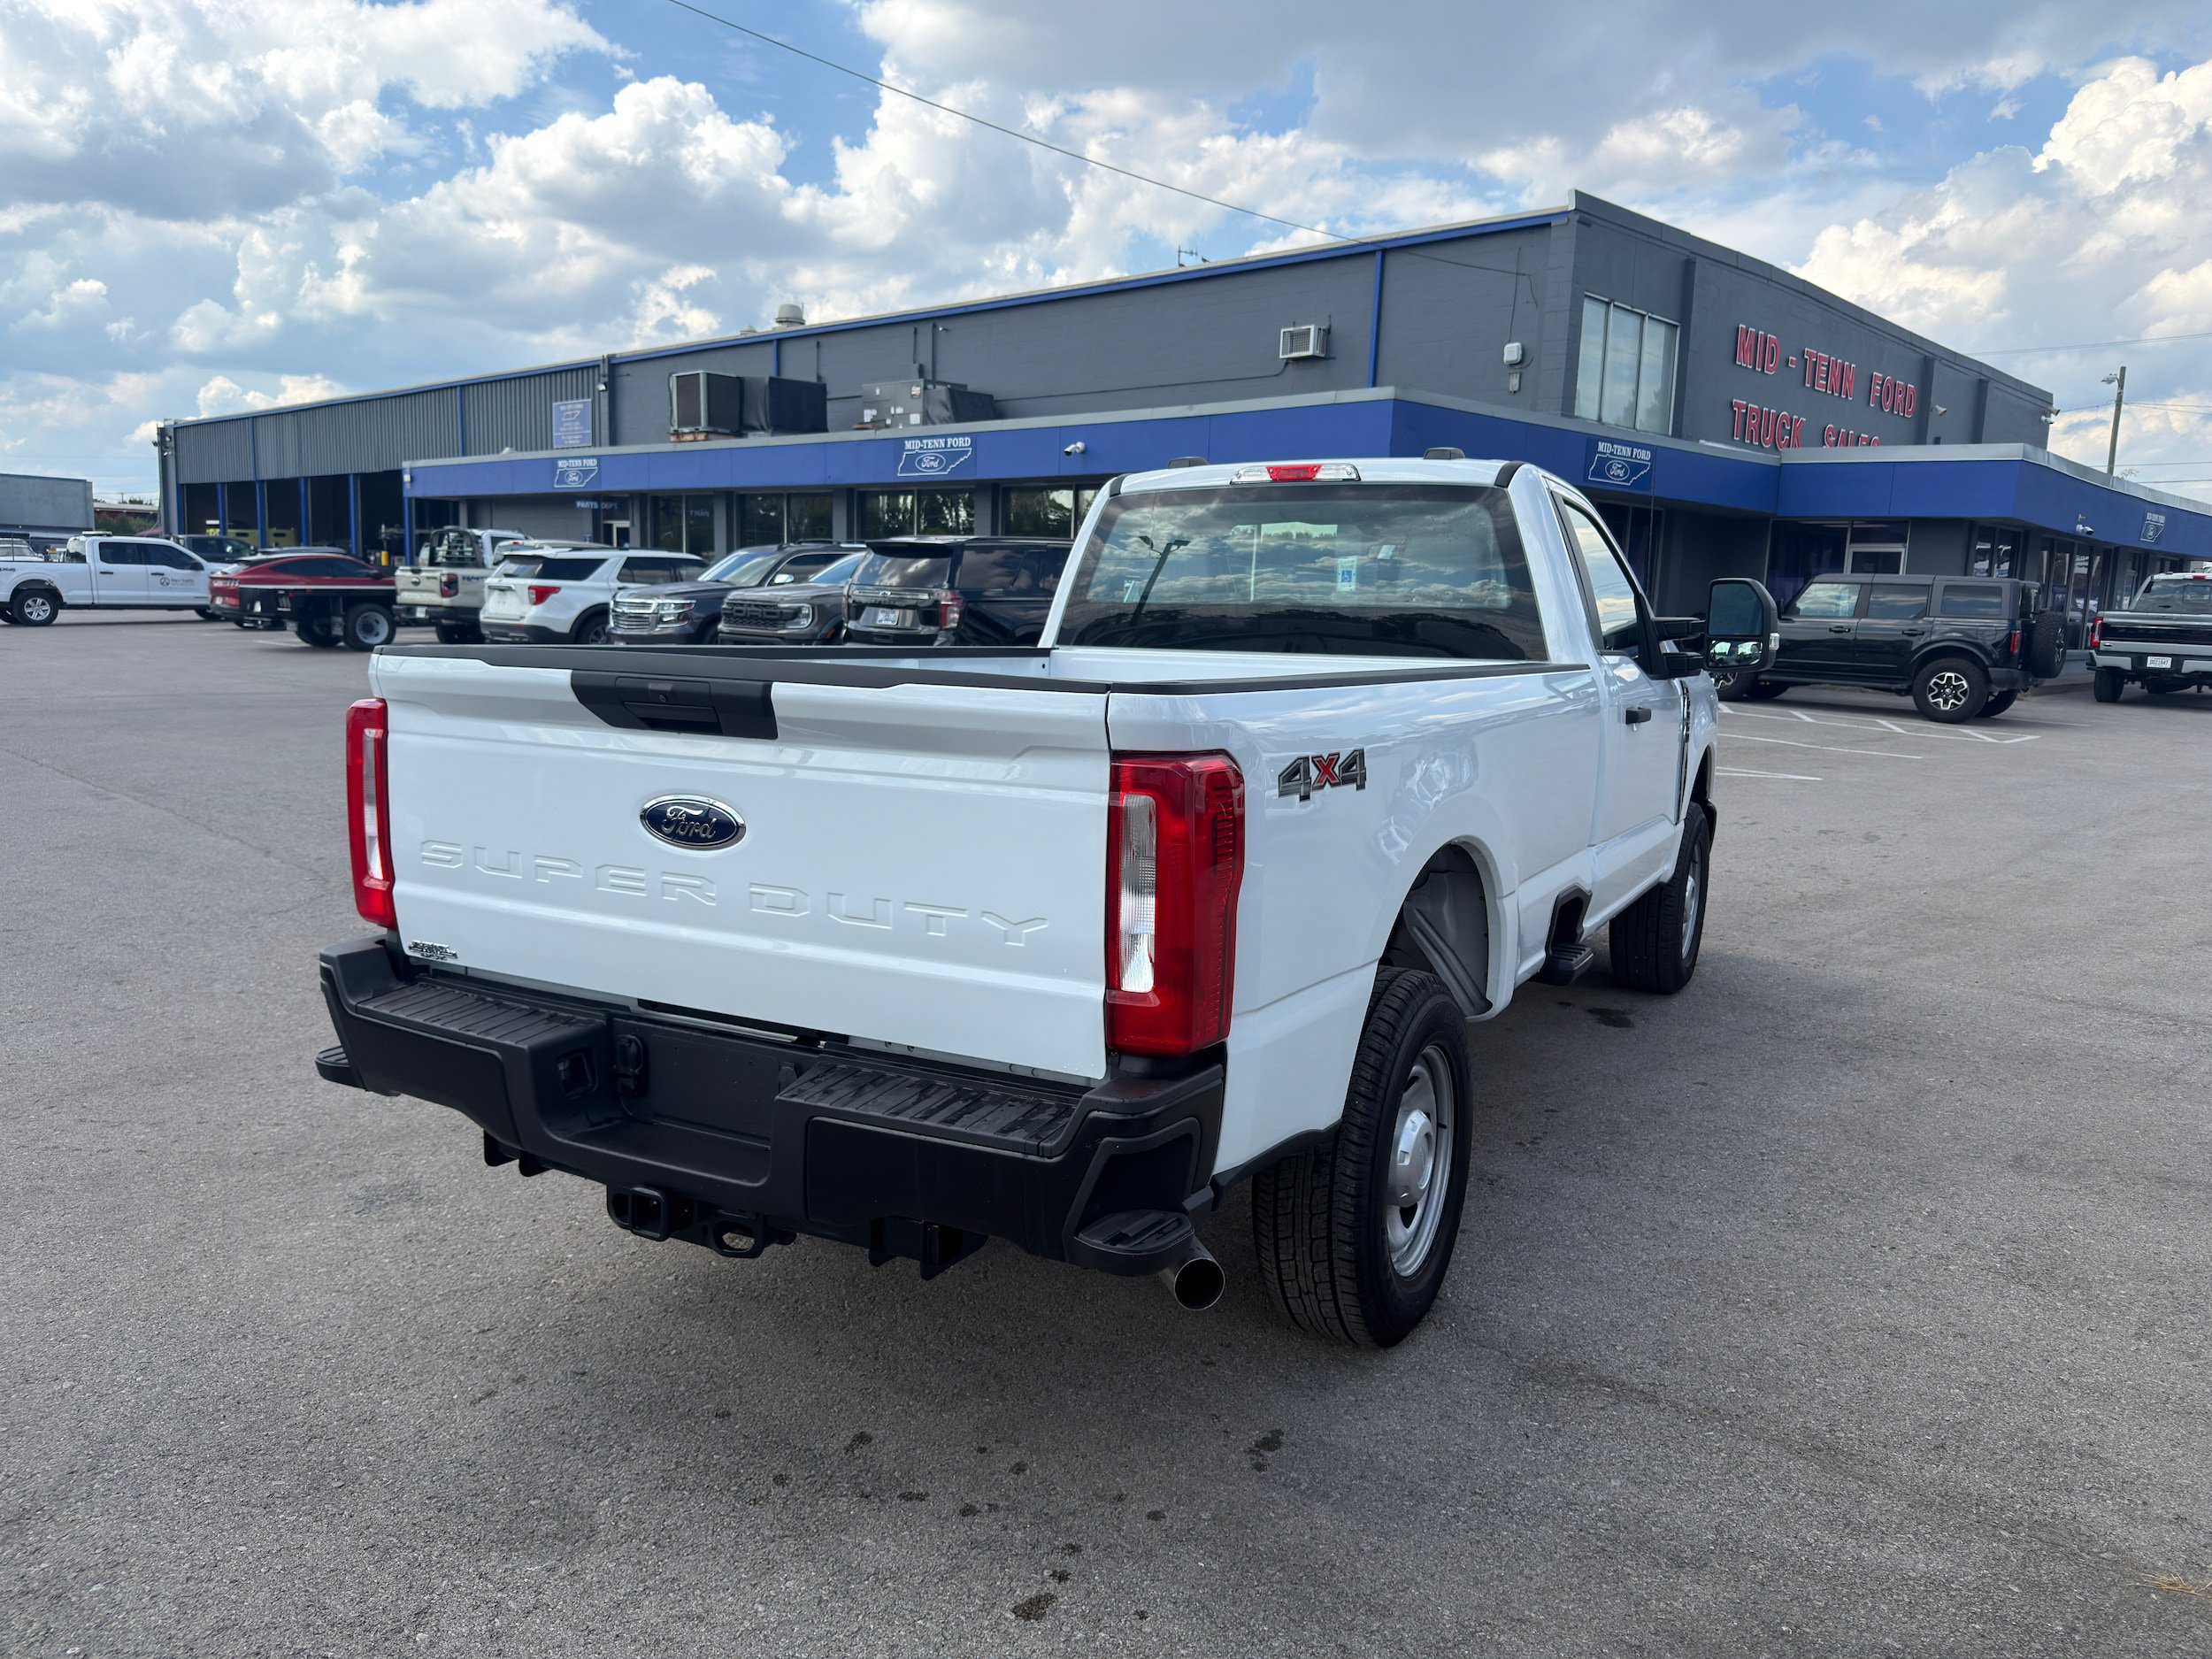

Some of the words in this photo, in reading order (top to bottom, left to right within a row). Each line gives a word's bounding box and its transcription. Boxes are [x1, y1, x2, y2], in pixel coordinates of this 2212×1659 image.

[1736, 324, 1780, 375] MID
[1804, 347, 1856, 400] TENN
[1870, 372, 1917, 419] FORD
[1732, 398, 1807, 451] TRUCK
[904, 438, 945, 450] MID-TENN
[947, 436, 971, 448] FORD
[1597, 442, 1632, 457] MID-TENN
[1632, 448, 1652, 461] FORD
[921, 456, 940, 468] Ford
[1610, 462, 1625, 477] Ford
[576, 500, 598, 509] PARTS
[661, 804, 718, 840] Ford
[420, 840, 717, 906] SUPER
[749, 882, 1048, 946] DUTY
